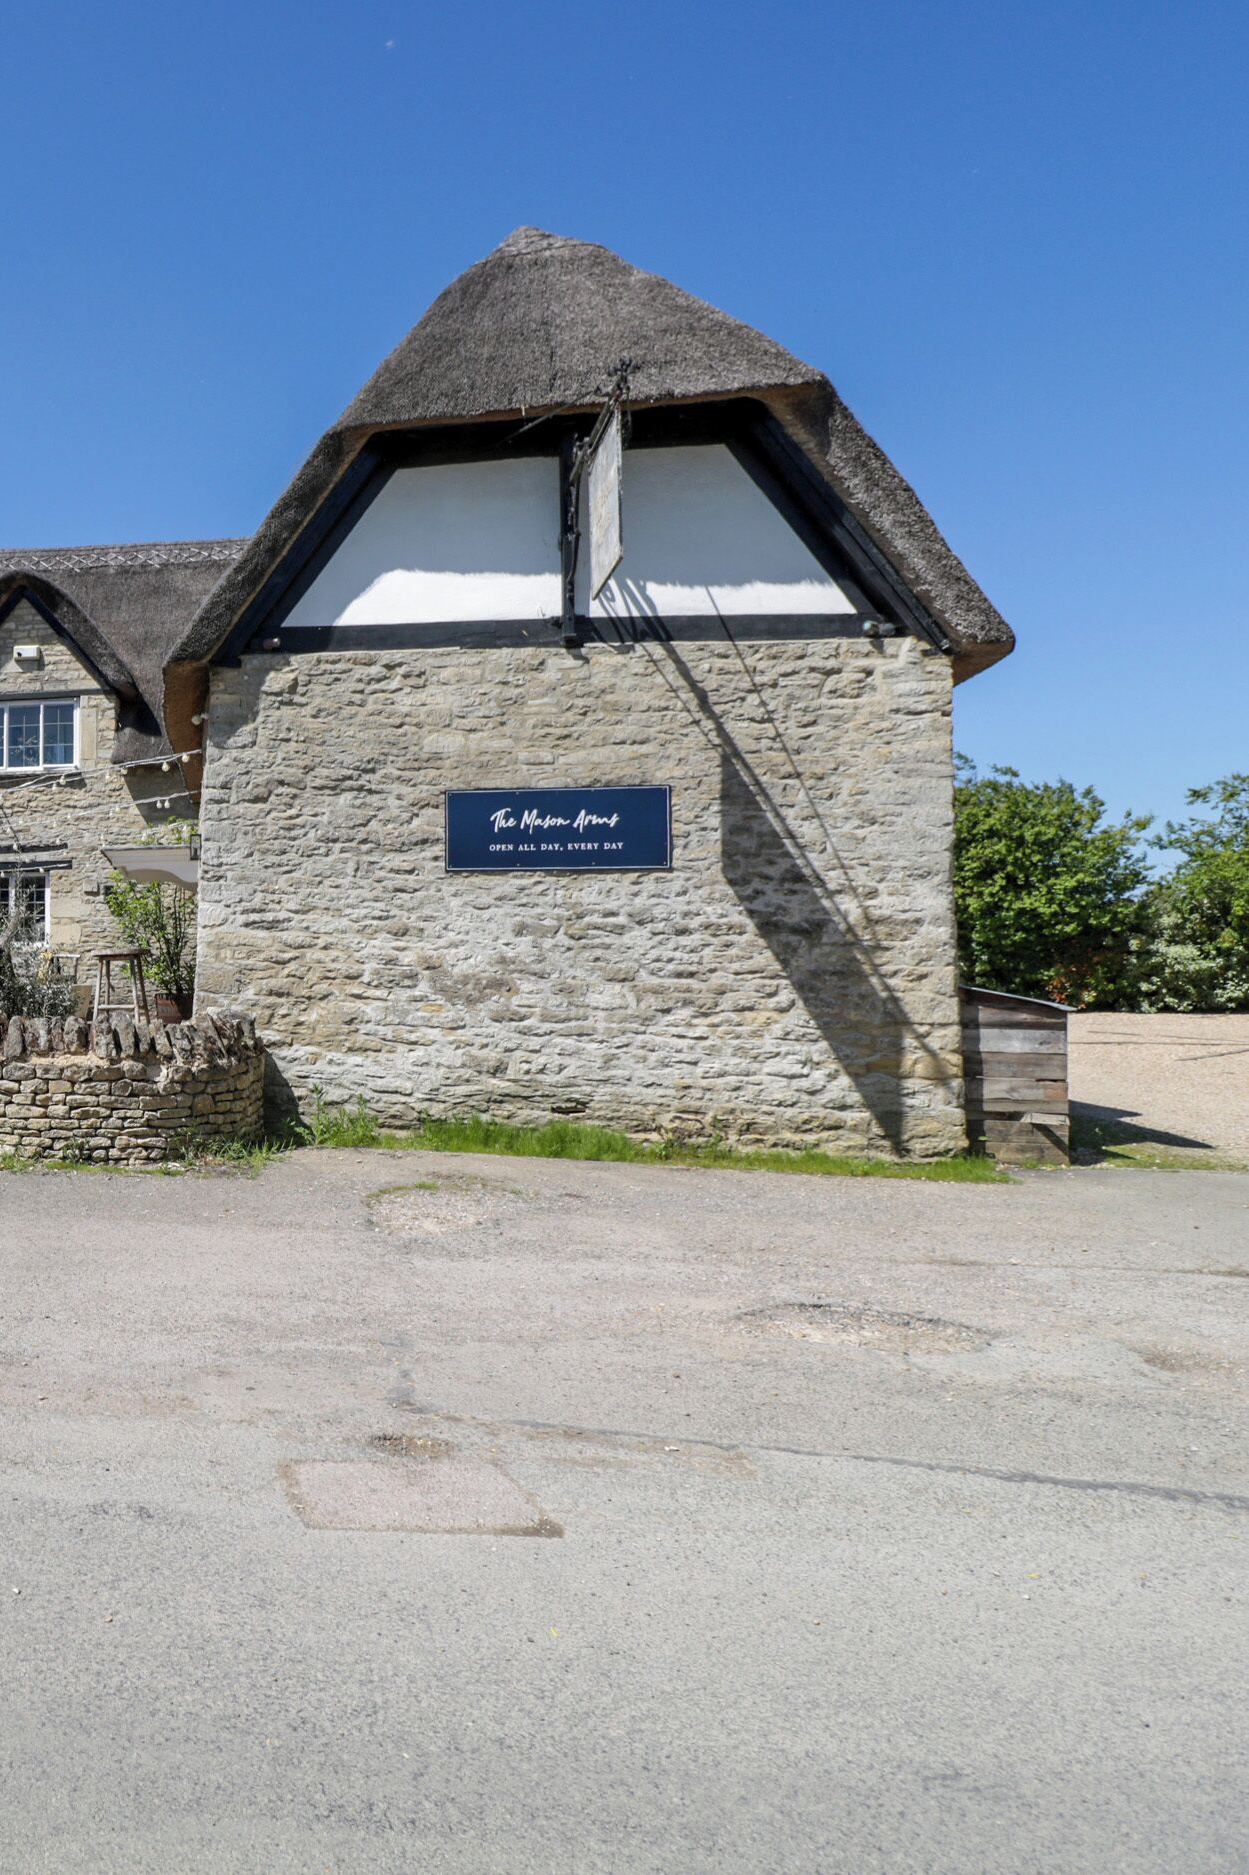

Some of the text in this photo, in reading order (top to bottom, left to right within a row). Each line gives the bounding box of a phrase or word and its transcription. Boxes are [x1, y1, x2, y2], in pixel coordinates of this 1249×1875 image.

[490, 808, 620, 834] The Mason Arms
[489, 842, 624, 852] OPEN ALL DAY, EVERY DAY
